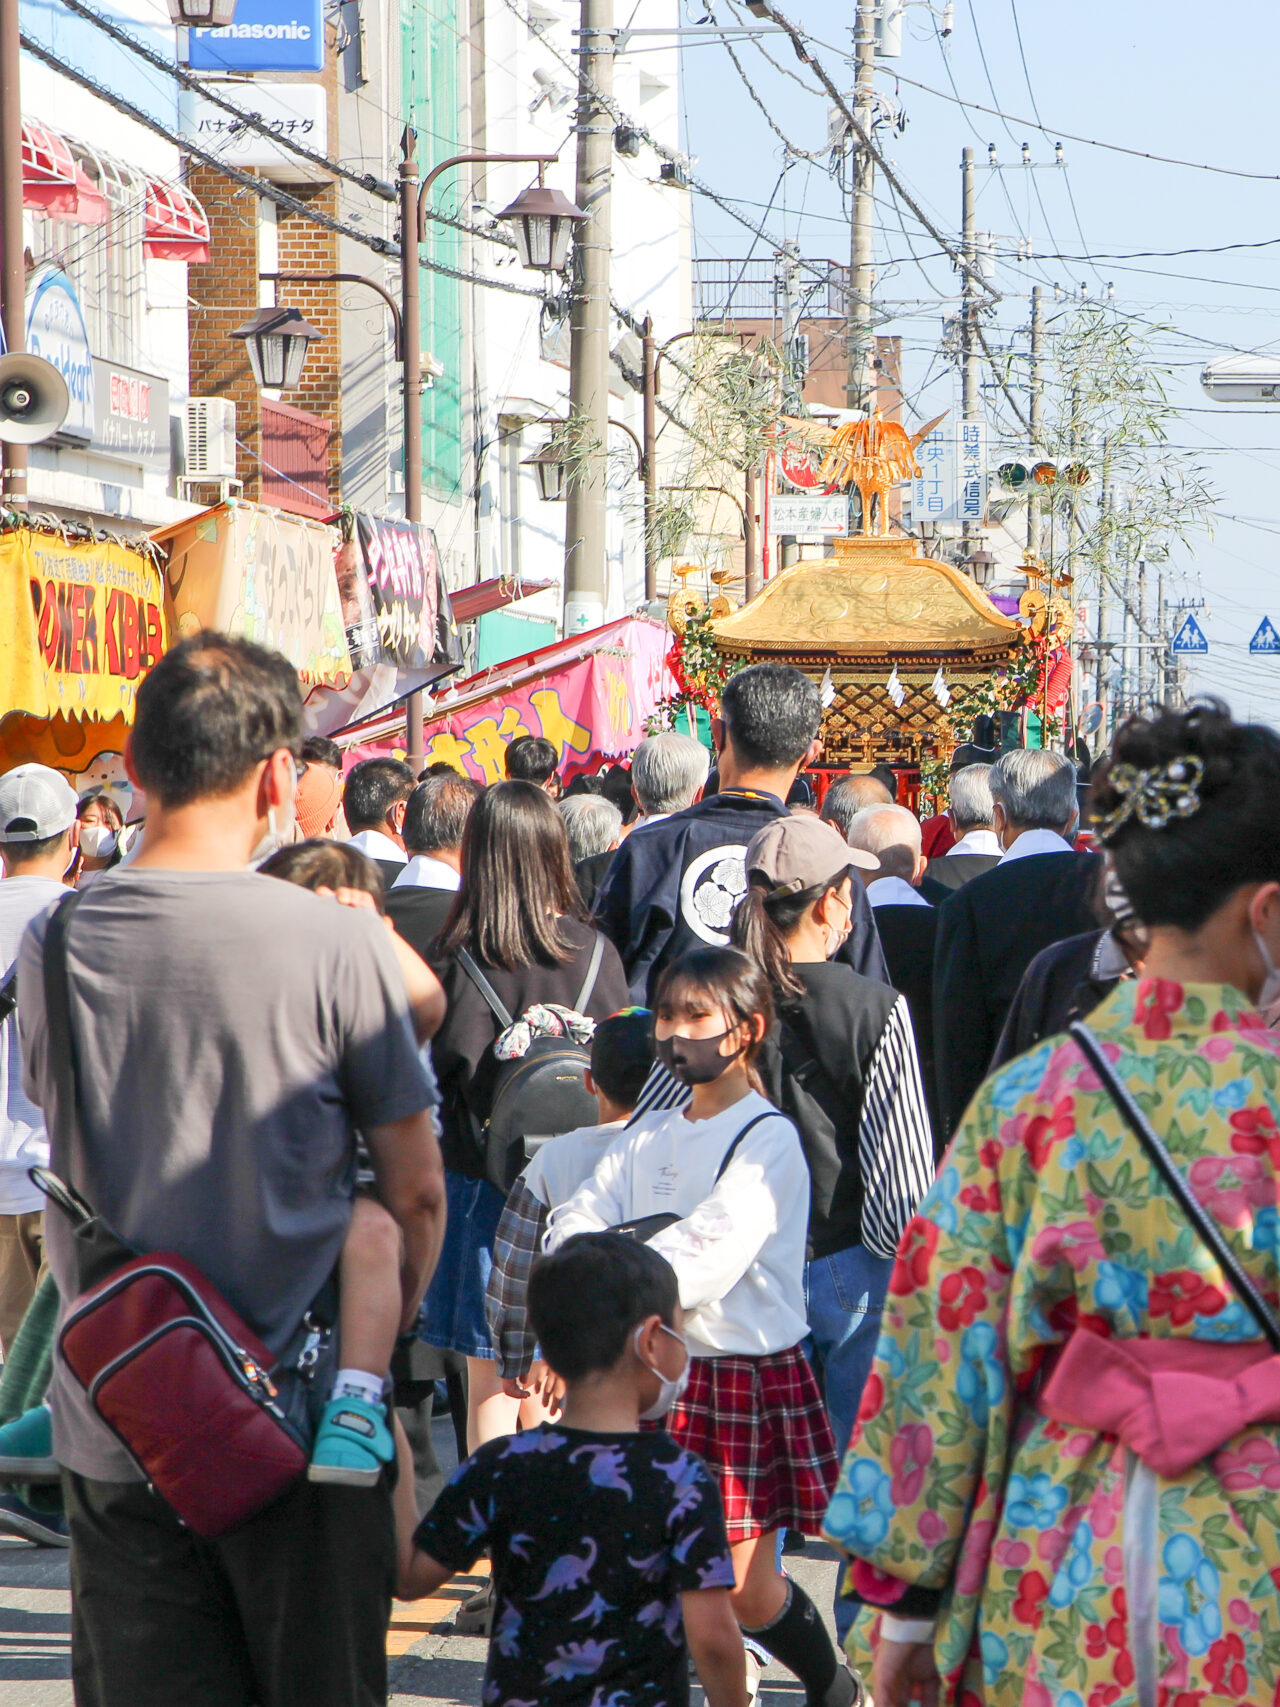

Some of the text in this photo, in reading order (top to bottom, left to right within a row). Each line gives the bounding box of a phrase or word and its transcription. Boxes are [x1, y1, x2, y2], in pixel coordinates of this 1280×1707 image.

[195, 20, 311, 40] Panasonic
[963, 425, 981, 516] 時差式信号
[773, 505, 845, 522] 松本産婦人科
